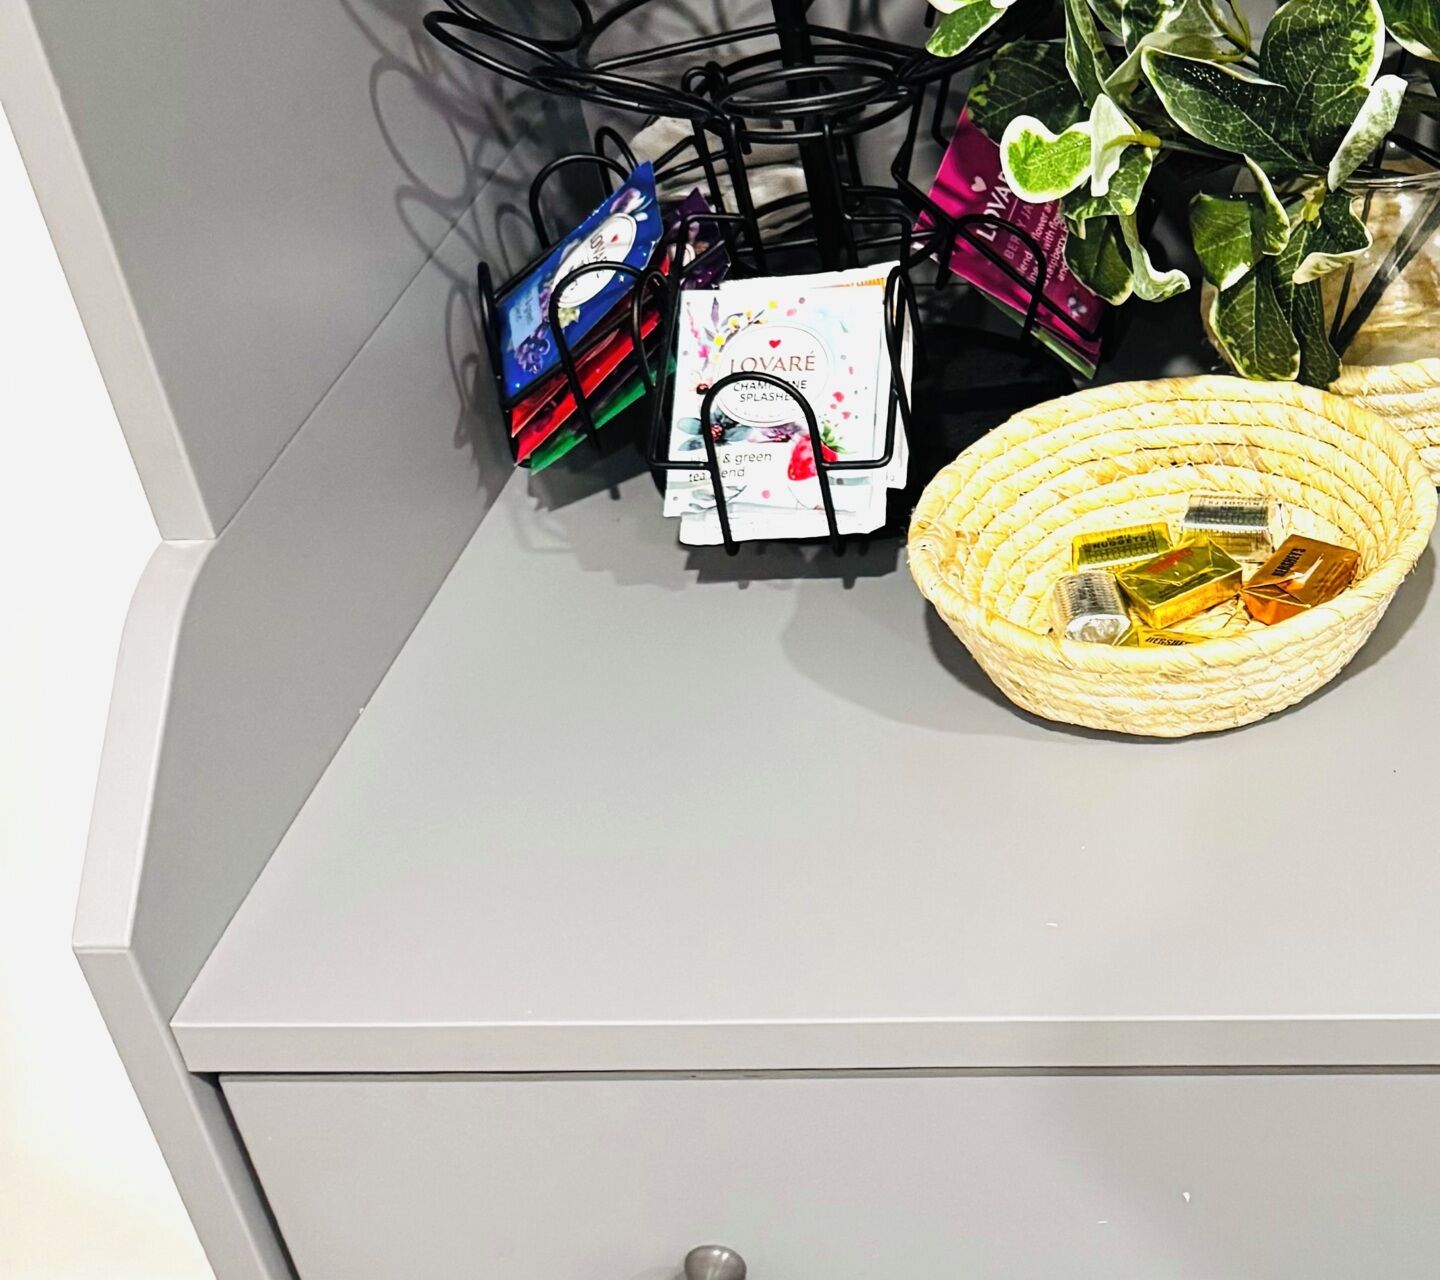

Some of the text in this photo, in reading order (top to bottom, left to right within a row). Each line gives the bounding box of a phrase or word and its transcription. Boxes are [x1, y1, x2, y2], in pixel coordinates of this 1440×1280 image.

[730, 350, 816, 374] LOVARÉ
[733, 379, 808, 392] CHAMNE
[739, 392, 796, 403] SPLASHE
[735, 452, 772, 466] green
[688, 466, 745, 483] tea end
[1093, 535, 1148, 549] NUGGETS
